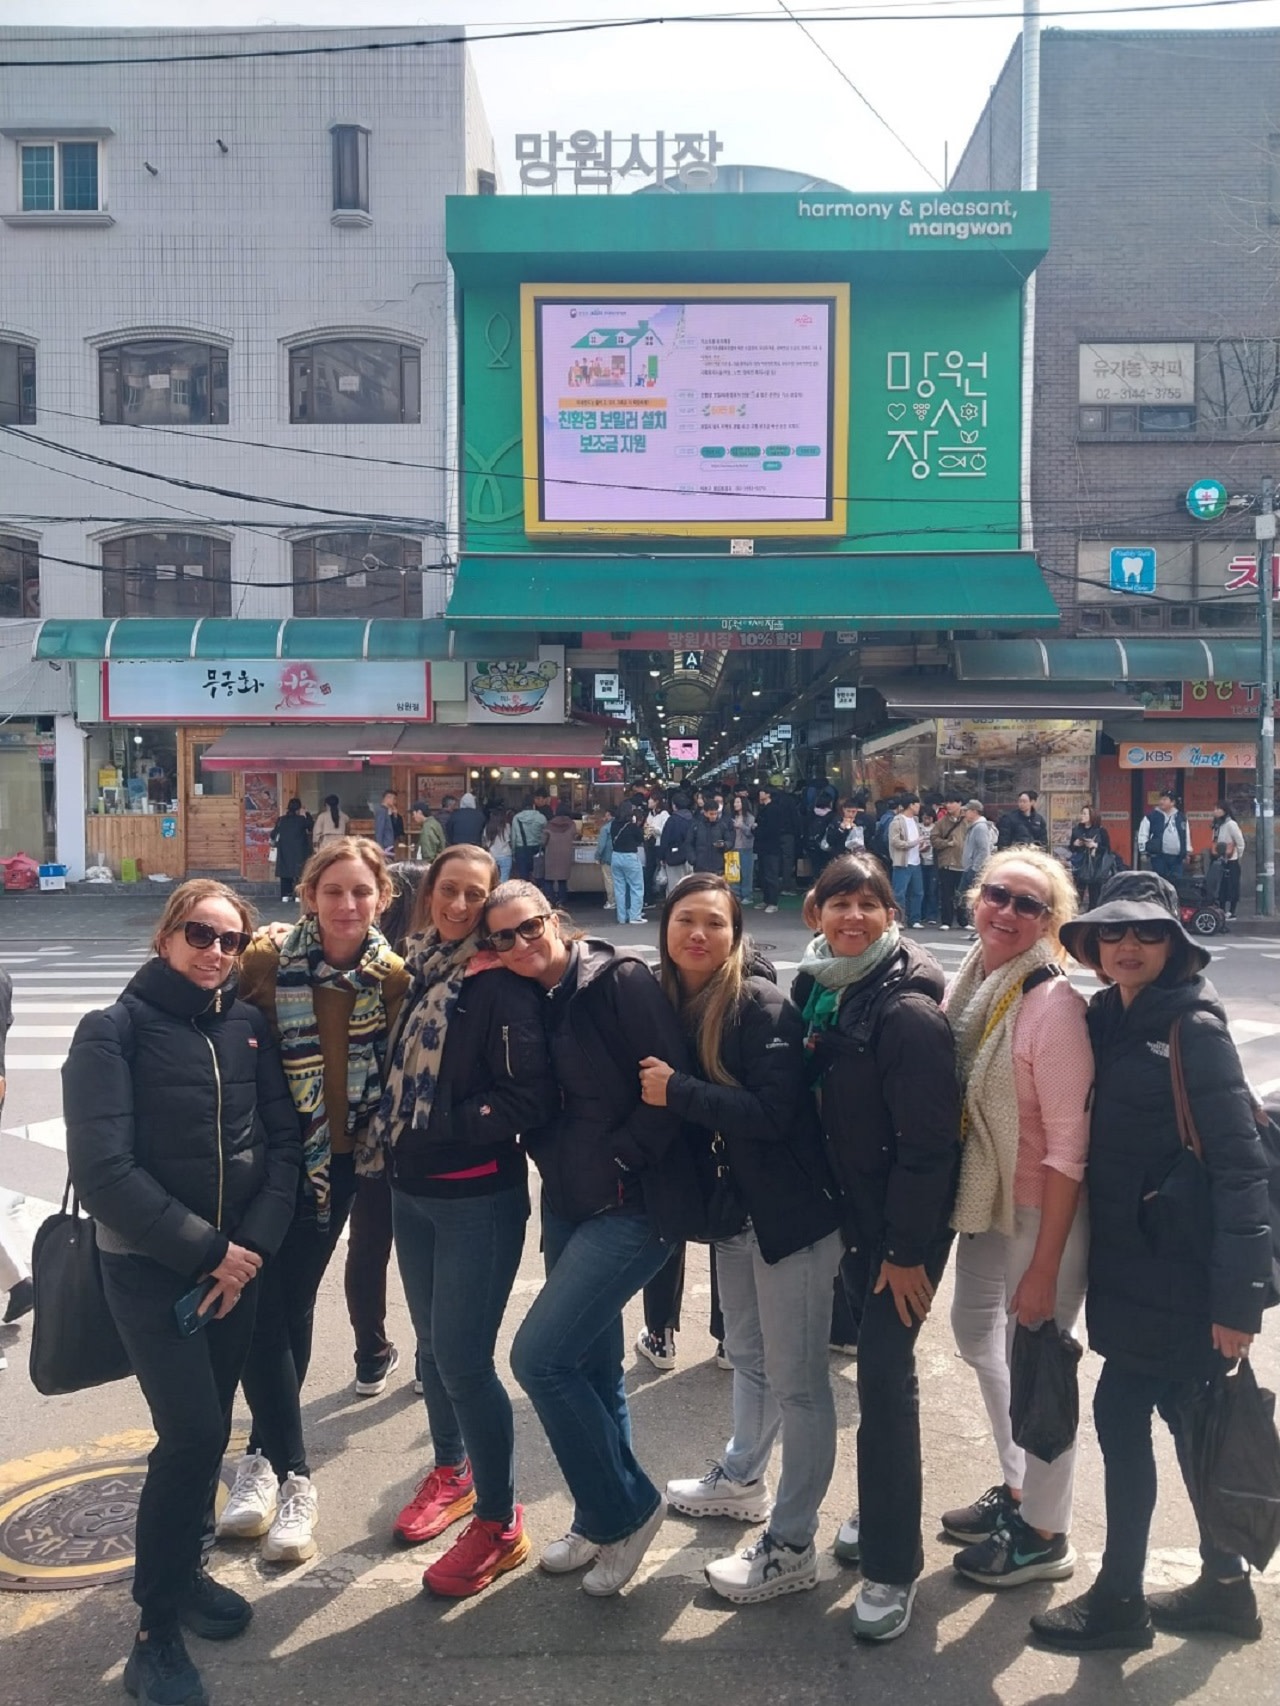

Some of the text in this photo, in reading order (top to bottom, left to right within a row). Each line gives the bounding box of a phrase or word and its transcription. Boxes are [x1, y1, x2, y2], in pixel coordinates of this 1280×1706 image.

[515, 129, 724, 187] 망원시장
[798, 199, 1018, 219] harmony & pleasant,
[909, 221, 1012, 239] mangwon
[1093, 359, 1182, 378] 유기농 커피
[558, 410, 667, 430] 친환경 보일러 설치
[580, 434, 646, 453] 보조금 지원
[667, 631, 802, 648] 망원시장 10% 할인
[686, 652, 698, 666] A
[203, 669, 265, 699] 무궁화
[1145, 751, 1173, 762] KBS
